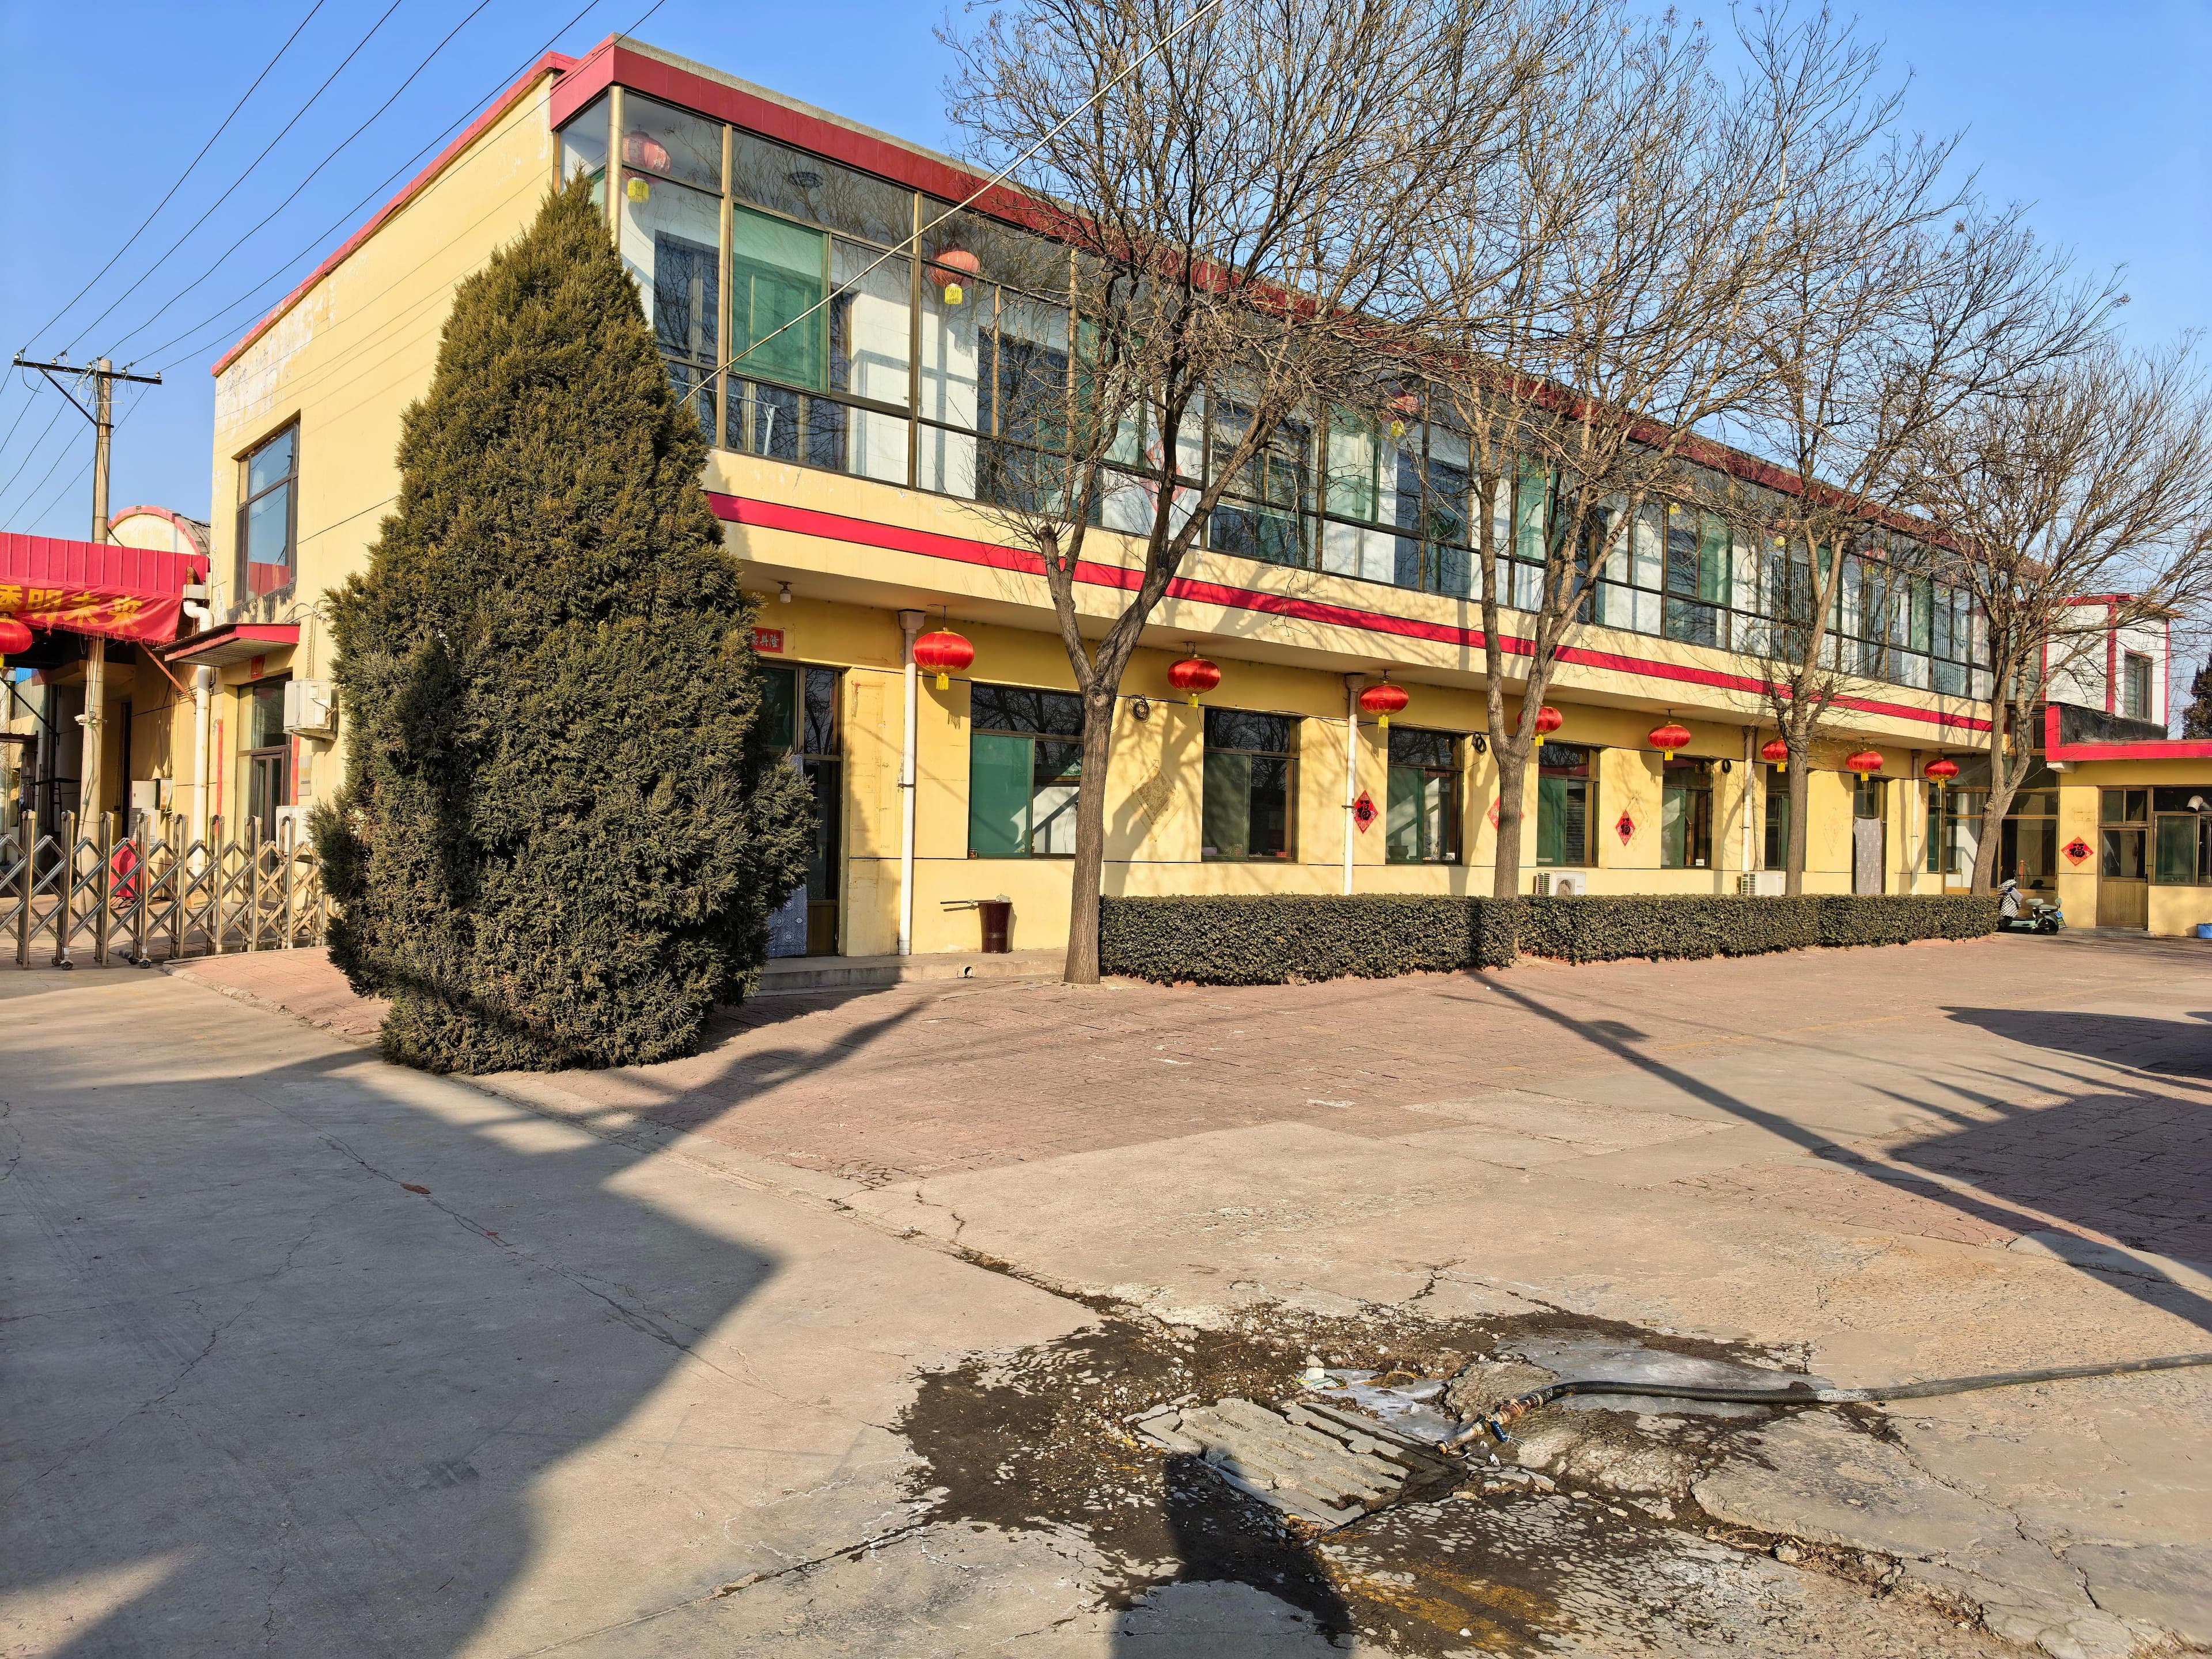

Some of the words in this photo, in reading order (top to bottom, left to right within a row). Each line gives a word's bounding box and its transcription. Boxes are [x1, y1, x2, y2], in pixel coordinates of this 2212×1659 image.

[1357, 800, 1372, 820] 福
[1620, 818, 1630, 835] 福
[2069, 843, 2085, 858] 福
